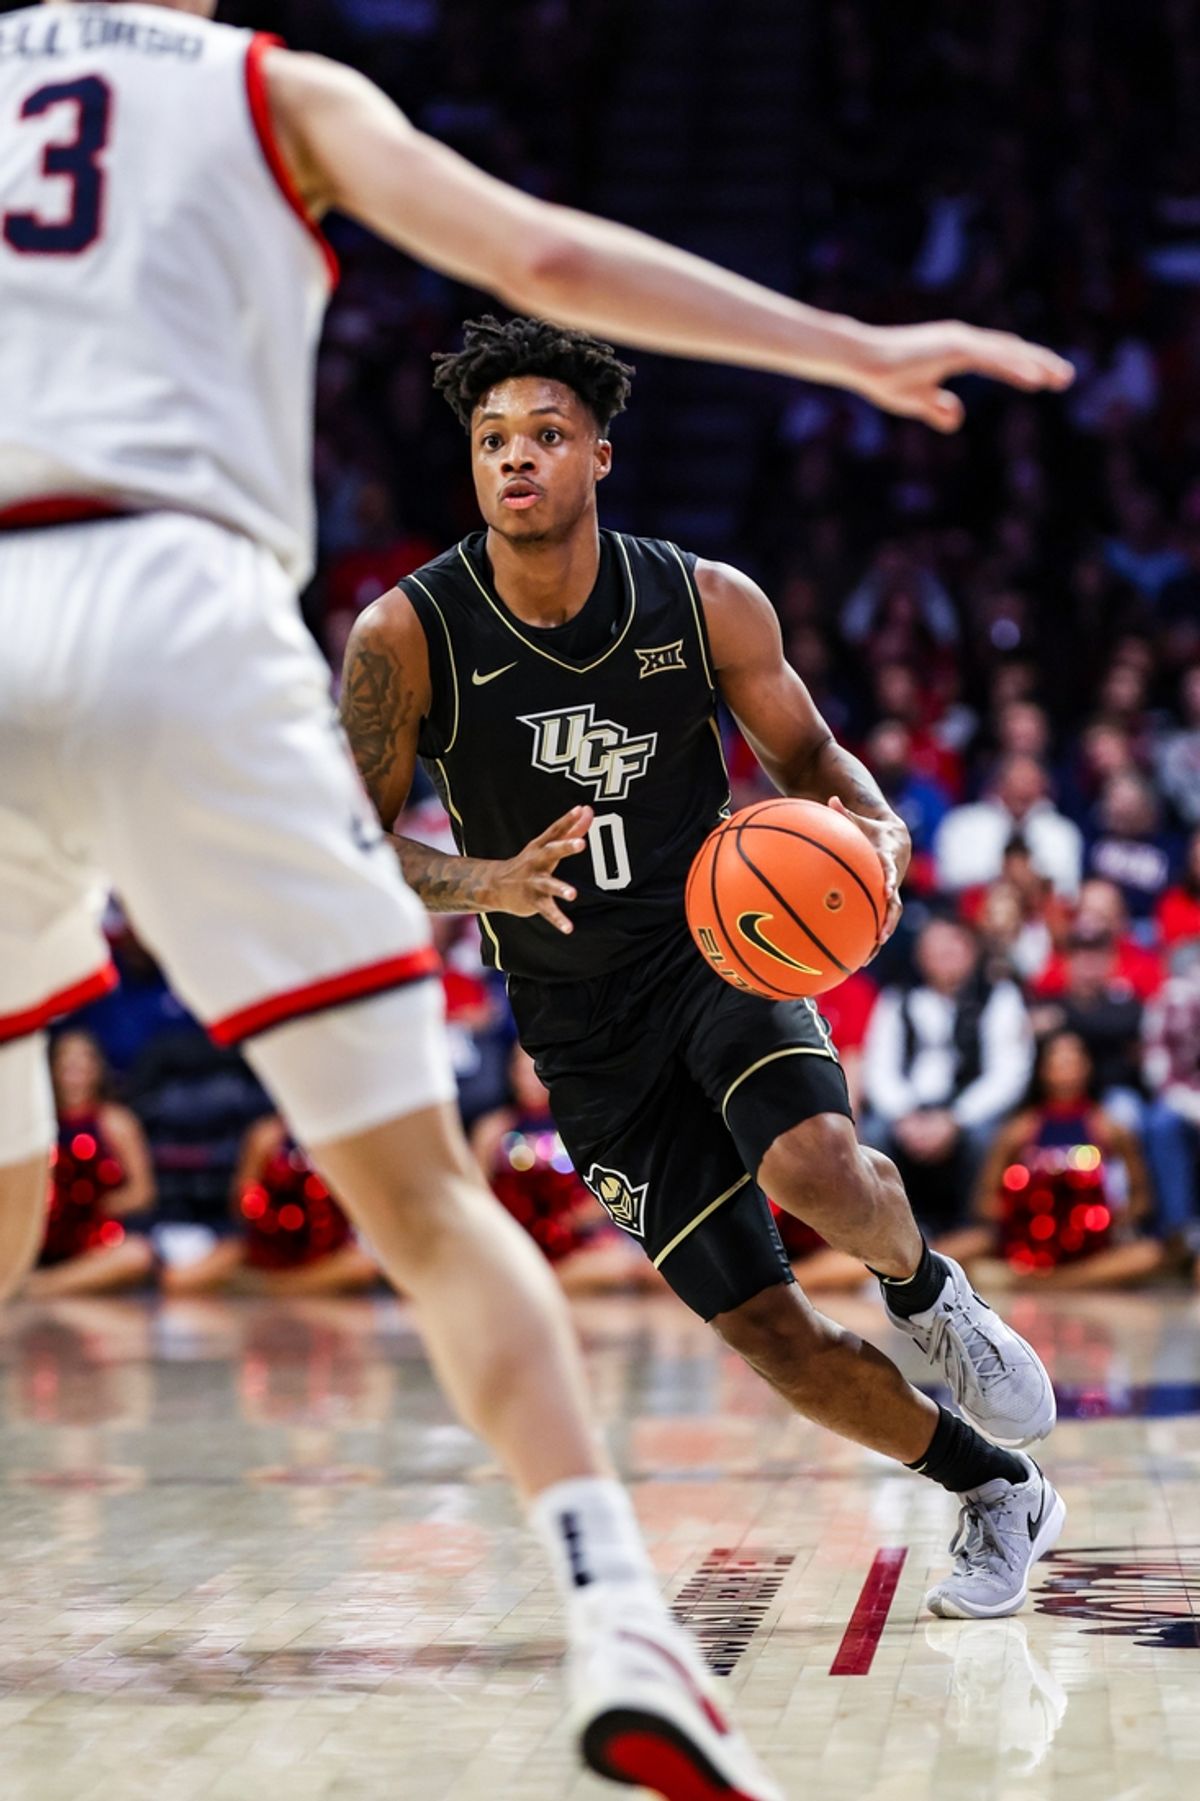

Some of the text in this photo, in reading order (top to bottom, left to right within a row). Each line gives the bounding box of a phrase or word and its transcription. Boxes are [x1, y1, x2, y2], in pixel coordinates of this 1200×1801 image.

[3, 73, 111, 256] 3
[528, 706, 655, 800] UCF
[588, 812, 632, 890] 0
